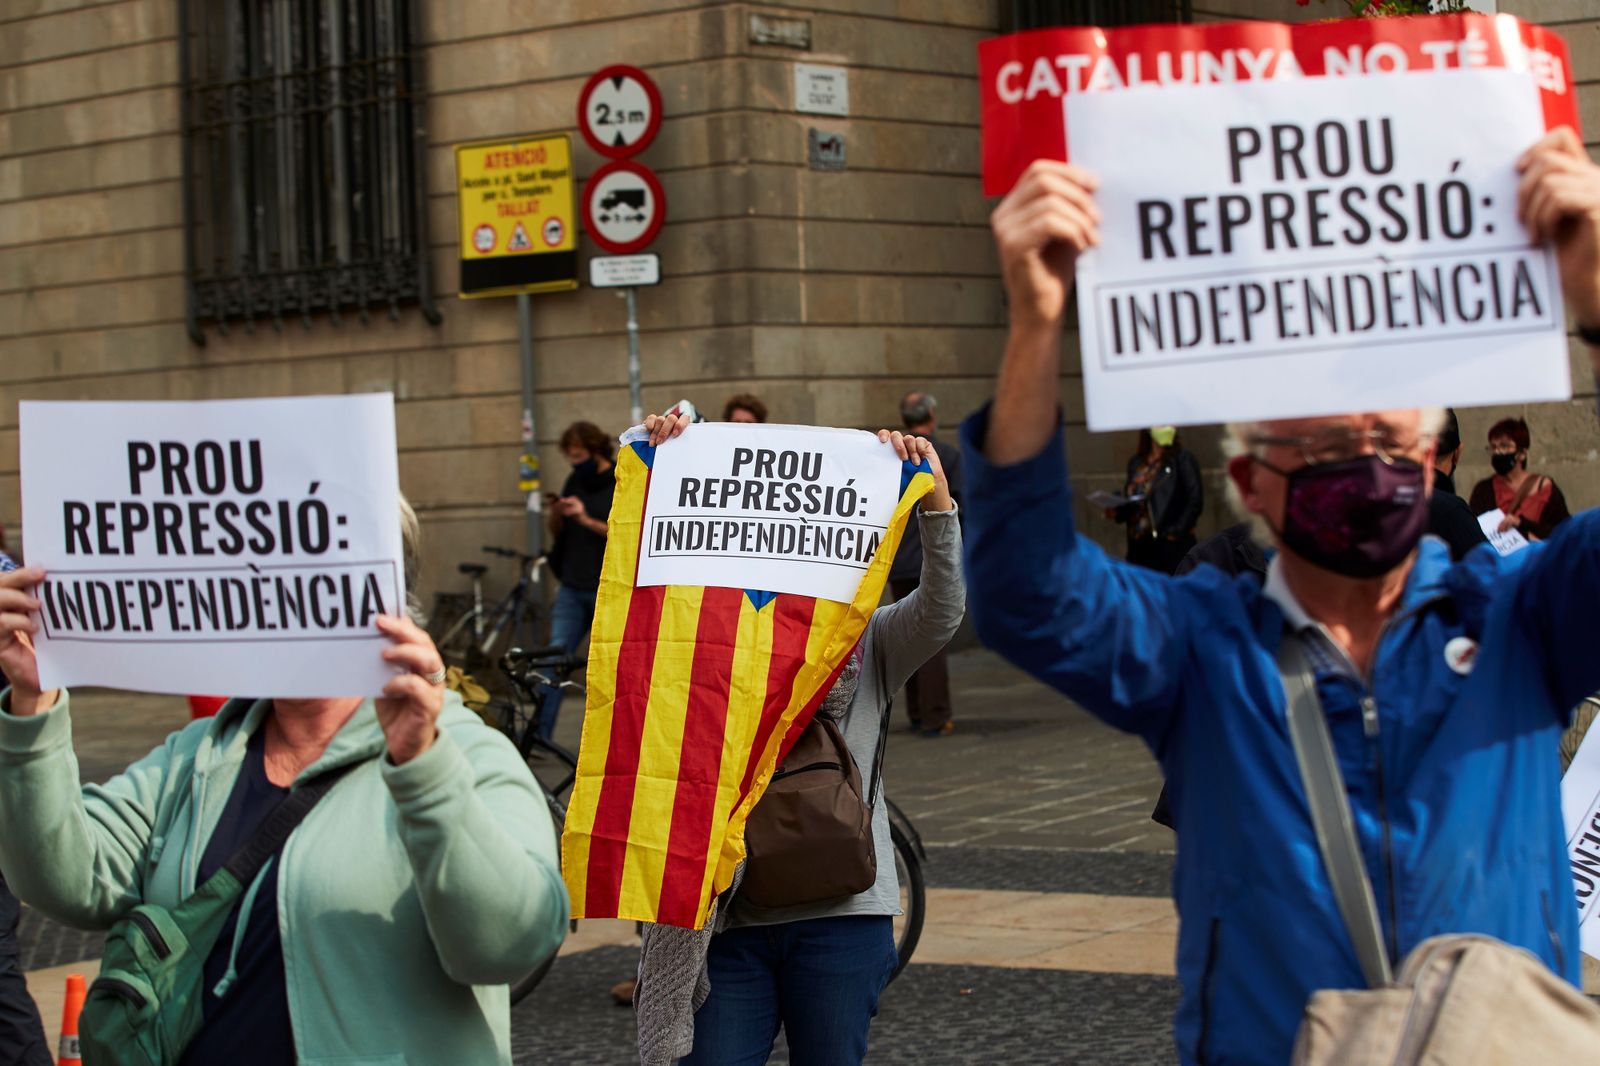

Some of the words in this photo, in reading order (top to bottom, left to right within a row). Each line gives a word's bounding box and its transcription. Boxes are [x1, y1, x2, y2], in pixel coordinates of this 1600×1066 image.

[1228, 118, 1396, 184] PROU
[1138, 160, 1496, 261] REPRESSIÓ:
[1110, 256, 1544, 356] INDEPENDÈNCIA
[127, 439, 263, 496] PROU
[731, 447, 823, 482] PROU
[63, 481, 349, 556] REPRESSIÓ:
[678, 478, 868, 518] REPRESSIÓ:
[655, 517, 881, 564] INDEPENDÈNCIA
[43, 563, 387, 632] INDEPENDÈNCIA
